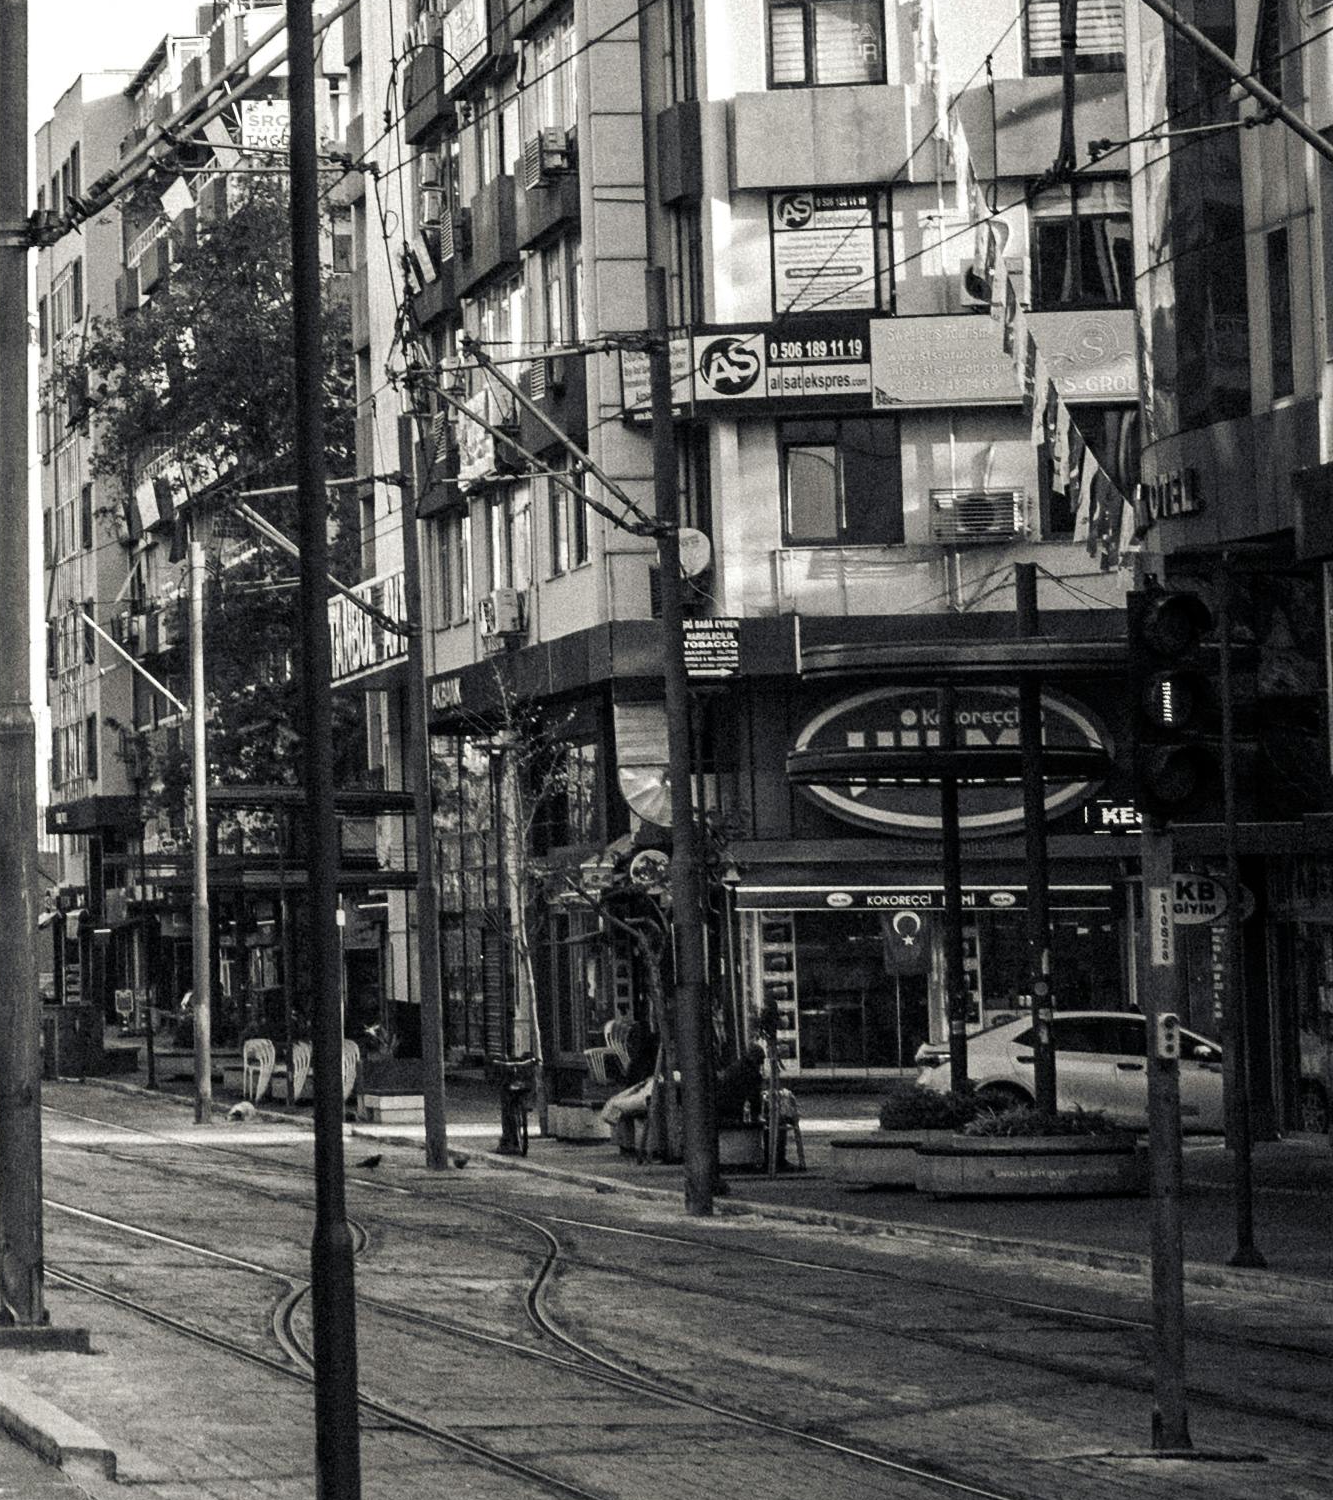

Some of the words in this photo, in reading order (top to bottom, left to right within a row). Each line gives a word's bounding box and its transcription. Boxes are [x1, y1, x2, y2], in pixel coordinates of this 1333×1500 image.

[708, 343, 759, 388] AS
[770, 342, 778, 358] 0
[780, 341, 803, 358] 506
[805, 340, 827, 357] 189
[830, 340, 844, 356] 11
[848, 339, 863, 356] 19
[683, 641, 739, 649] TOBACCO
[922, 707, 1020, 727] Koreççi
[1176, 881, 1216, 900] KB
[867, 892, 932, 906] KOKOREÇÇİ
[1173, 903, 1216, 915] GİYİM
